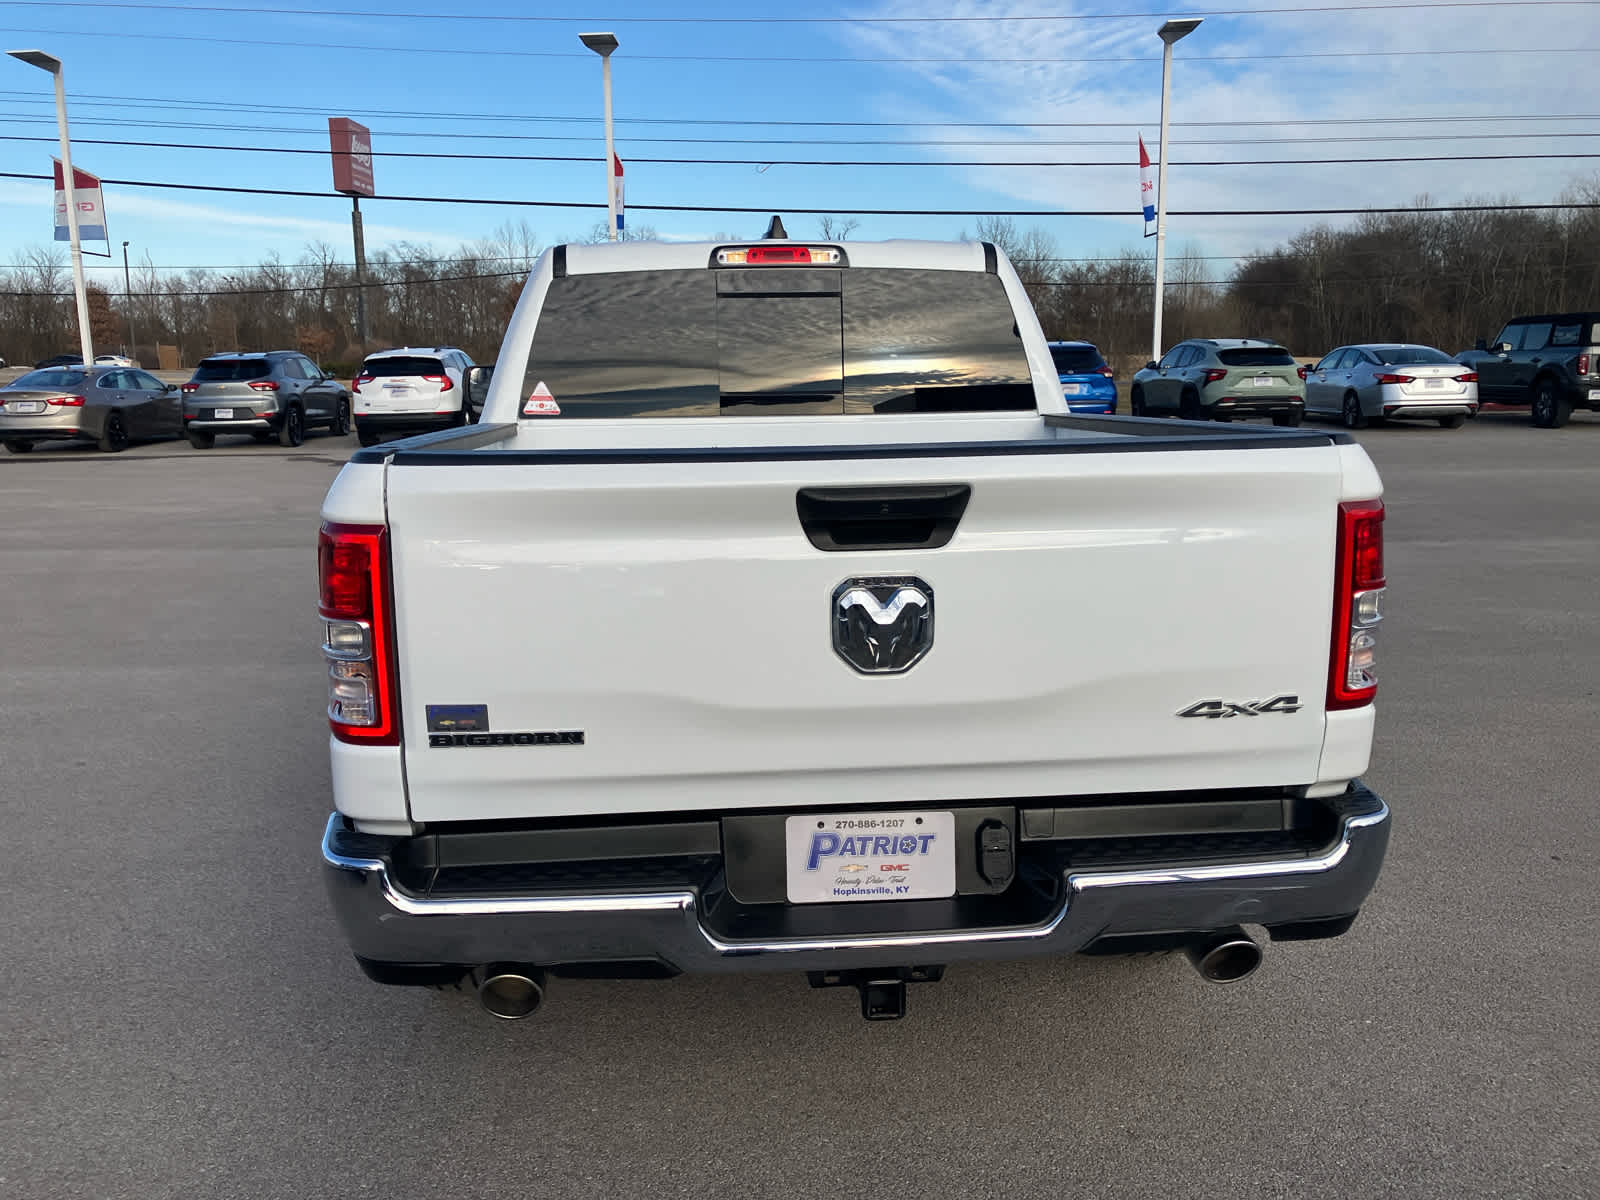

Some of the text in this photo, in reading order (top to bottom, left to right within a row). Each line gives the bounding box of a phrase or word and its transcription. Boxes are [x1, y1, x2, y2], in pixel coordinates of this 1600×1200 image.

[835, 819, 905, 829] 270-886-1207
[806, 831, 937, 872] PATRIOT
[833, 886, 910, 897] Hopkinsville, KY
